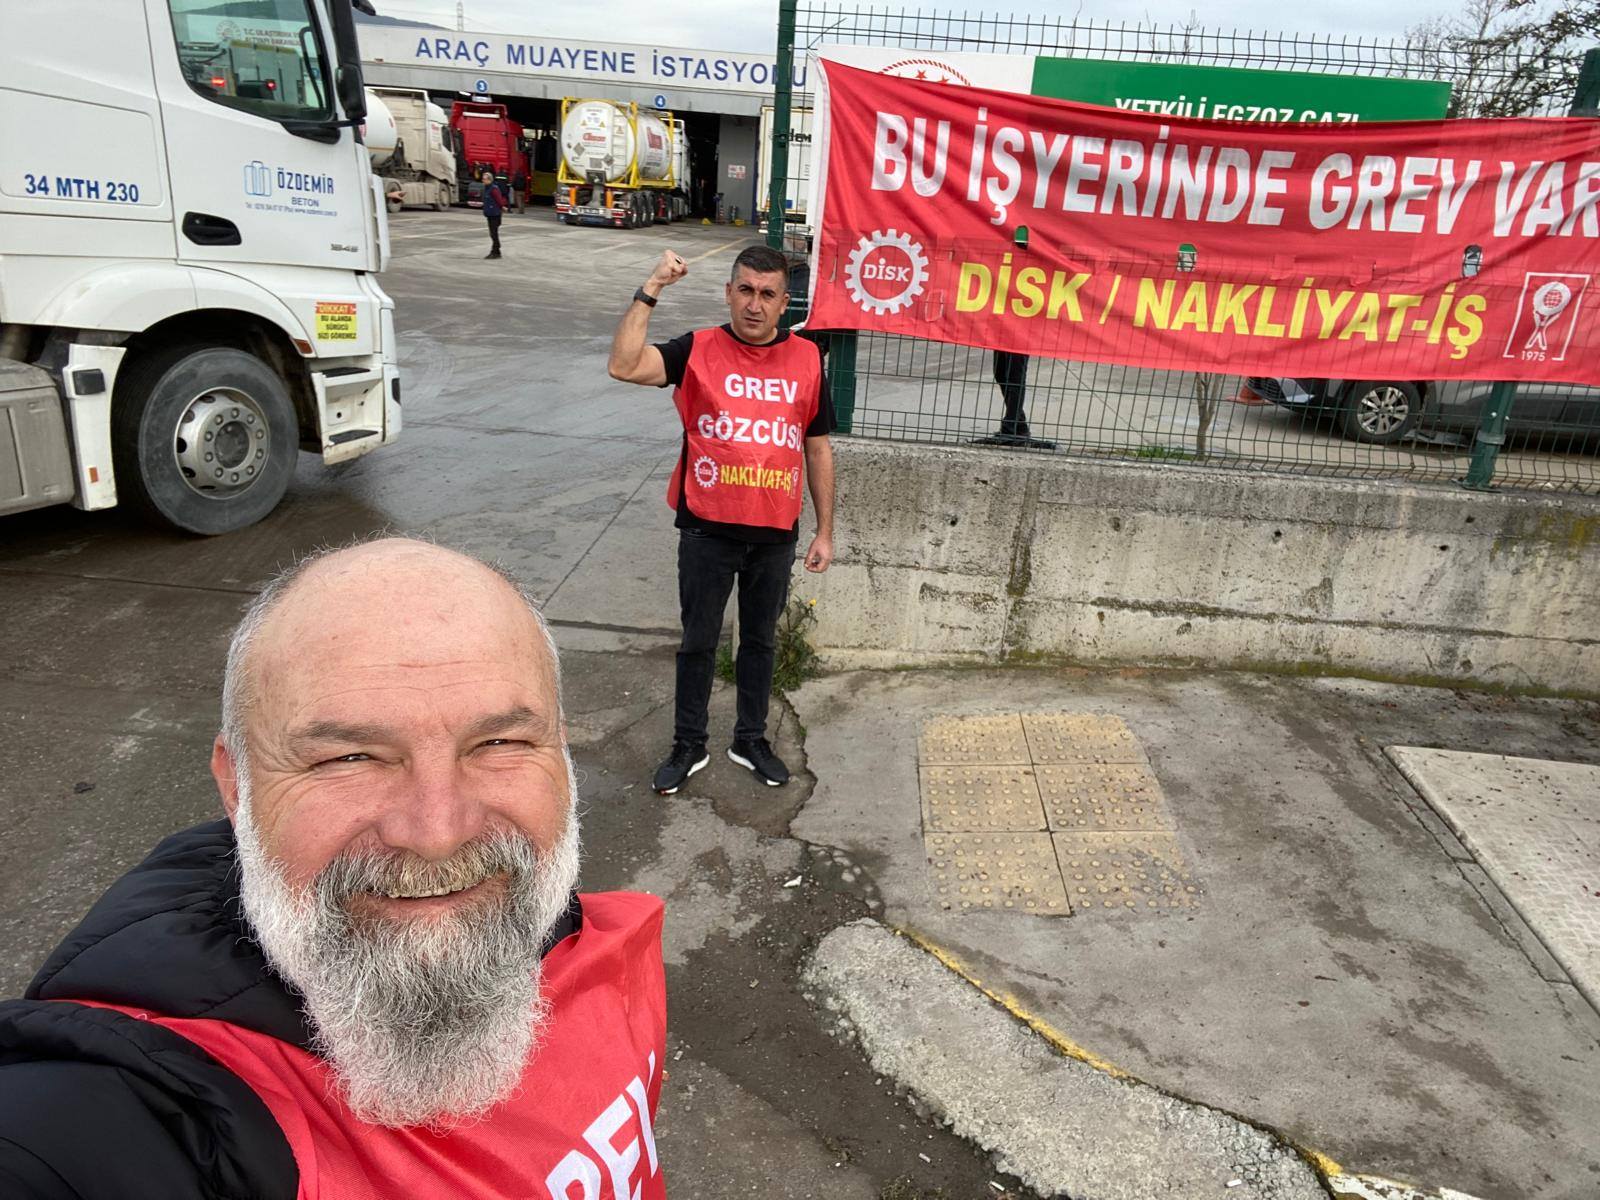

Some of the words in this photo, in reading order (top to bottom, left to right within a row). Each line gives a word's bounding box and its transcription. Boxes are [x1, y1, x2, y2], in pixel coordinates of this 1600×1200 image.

[416, 38, 489, 67] ARAÇ
[507, 44, 635, 73] MUAYENE
[24, 173, 50, 195] 34
[56, 177, 100, 199] MTH
[106, 182, 139, 202] 230
[277, 167, 334, 194] ÖZDEMİR
[871, 111, 950, 197] BU
[967, 107, 1296, 226] İŞYERİNDE
[1308, 152, 1482, 236] GREV
[1492, 160, 1600, 238] VAR
[291, 196, 320, 207] BETON
[863, 257, 911, 282] DİSK
[955, 252, 1091, 322] DİSK
[1098, 274, 1121, 325] /
[1133, 277, 1487, 360] NAKLİYAT-İŞ
[1521, 350, 1546, 362] 1975
[724, 373, 799, 404] GREV
[720, 463, 792, 497] NAKLİYAT-İŞ
